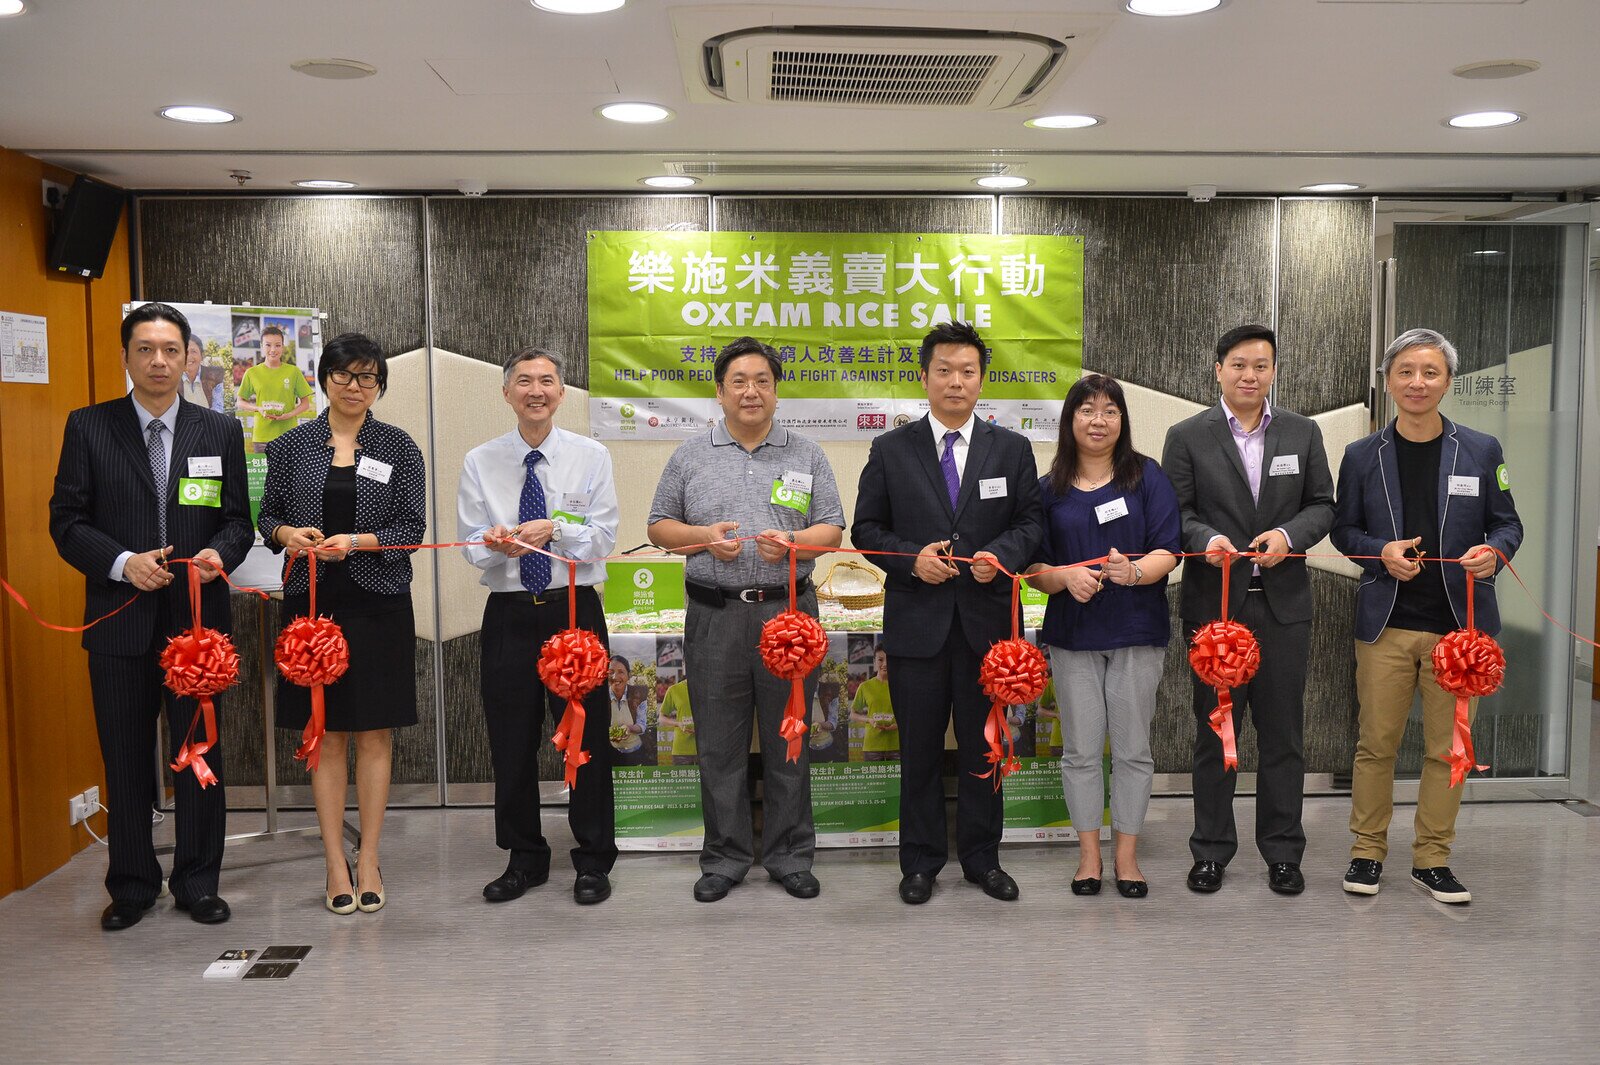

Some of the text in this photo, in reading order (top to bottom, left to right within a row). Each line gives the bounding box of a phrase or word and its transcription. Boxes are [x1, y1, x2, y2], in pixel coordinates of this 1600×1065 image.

[628, 250, 1045, 297] 樂施米義賣大行動
[681, 301, 992, 328] OXFAM RICE SALE
[615, 369, 647, 381] HELP
[651, 369, 684, 381] POOR
[688, 369, 713, 381] PEO
[800, 369, 837, 382] FIGHT
[841, 369, 895, 382] AGAINST
[989, 371, 1057, 383] DISASTERS
[1453, 375, 1517, 396] 訓練室
